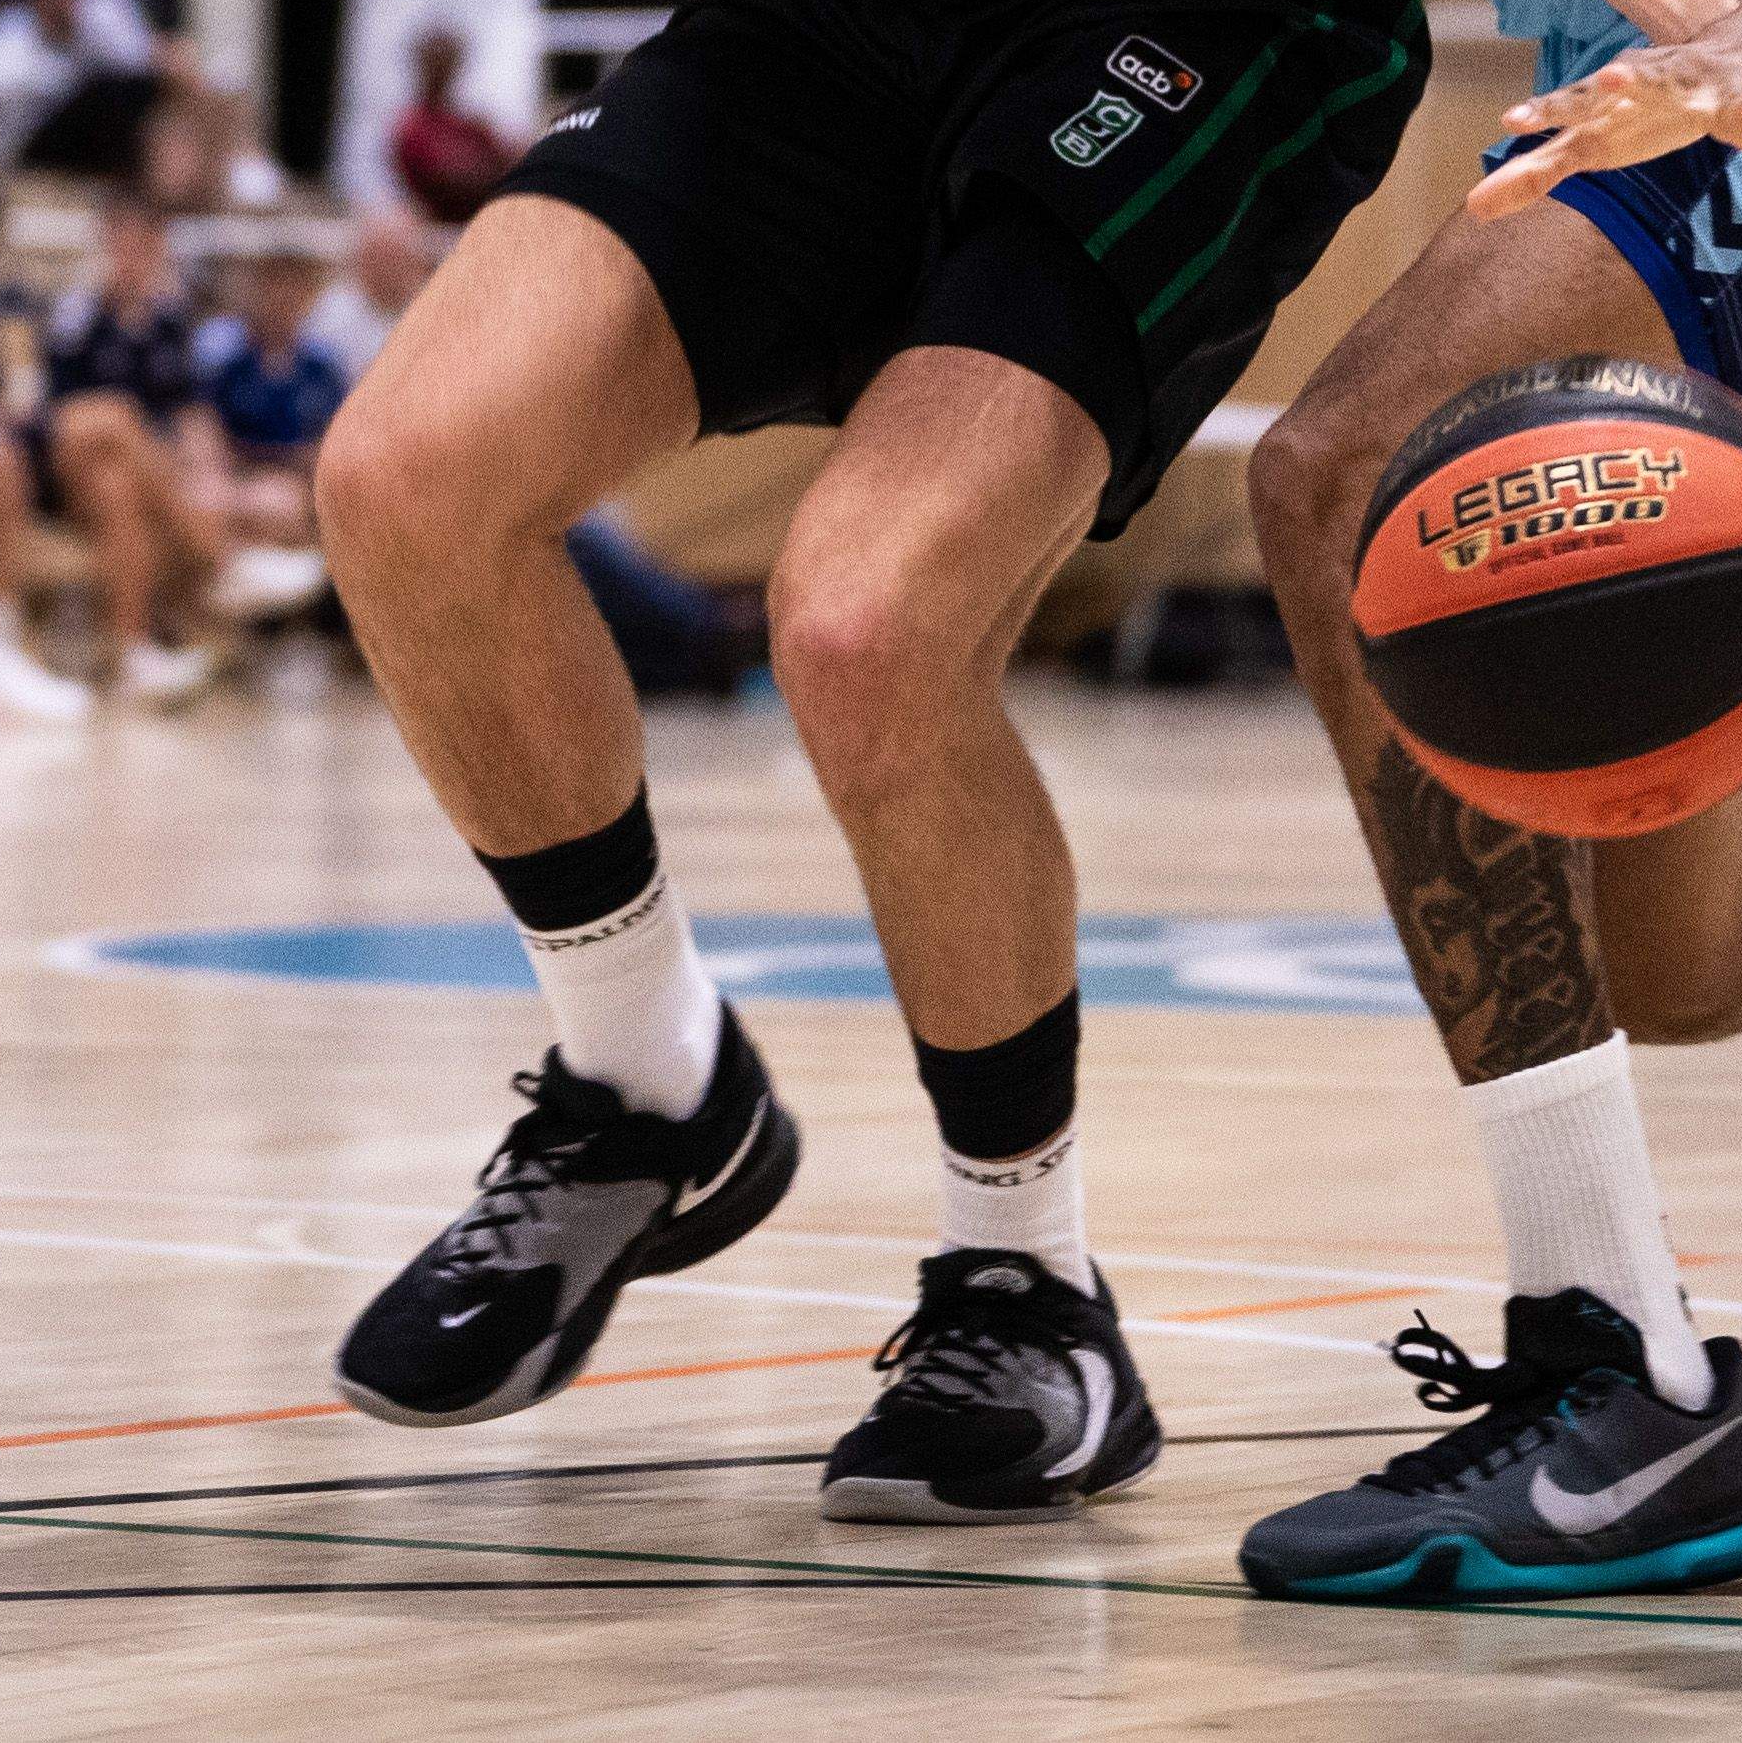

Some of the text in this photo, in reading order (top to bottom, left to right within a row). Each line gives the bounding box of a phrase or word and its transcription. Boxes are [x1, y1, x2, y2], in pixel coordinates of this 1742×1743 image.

[1119, 55, 1172, 94] acb
[1417, 451, 1684, 547] LEGACY
[1500, 495, 1668, 546] 1000
